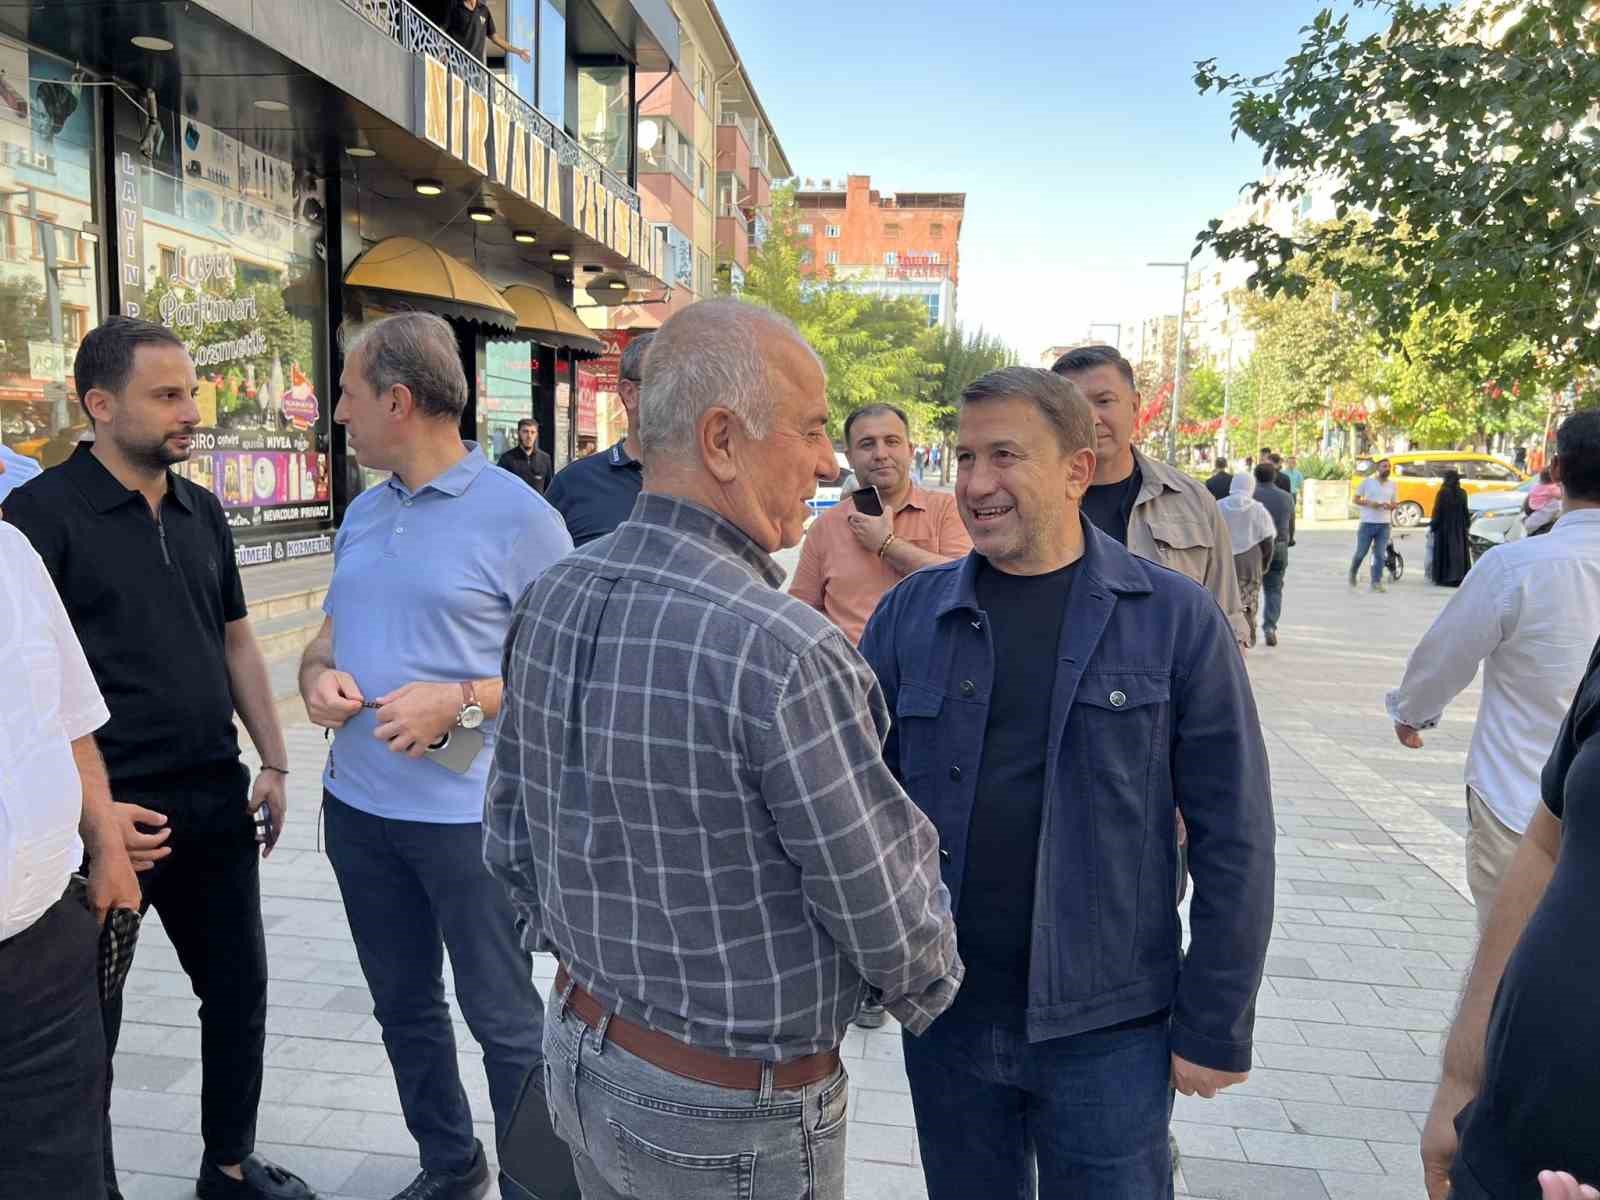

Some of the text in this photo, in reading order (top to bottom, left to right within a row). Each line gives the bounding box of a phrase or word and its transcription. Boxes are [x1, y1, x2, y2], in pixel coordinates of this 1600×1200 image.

[266, 436, 292, 449] NIVEA
[263, 507, 299, 522] NEVACOLOR
[301, 505, 329, 519] PRIVACY
[274, 541, 284, 560] &
[286, 534, 331, 557] KOZMETİK
